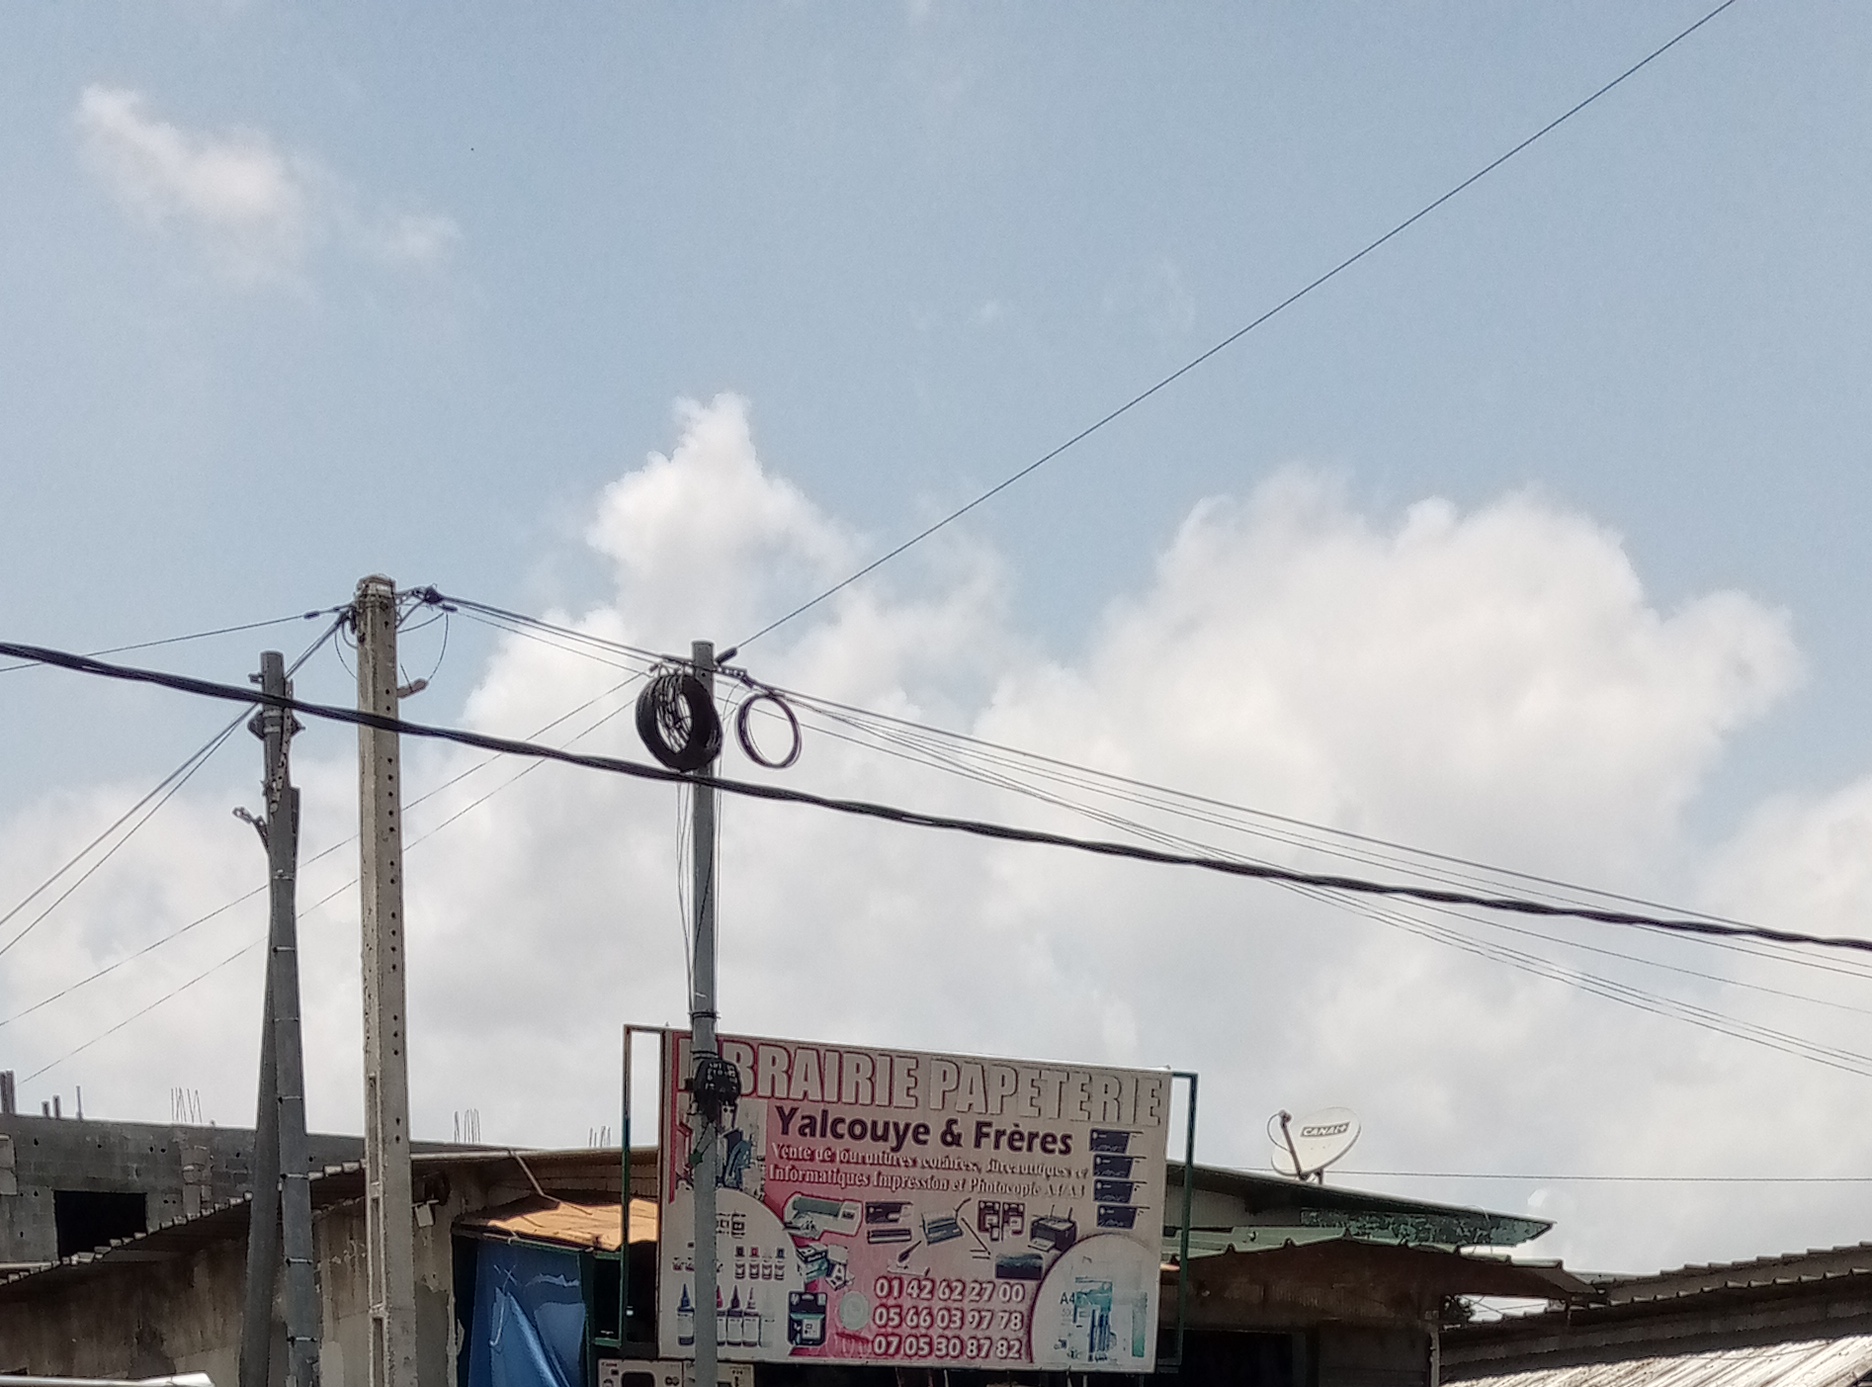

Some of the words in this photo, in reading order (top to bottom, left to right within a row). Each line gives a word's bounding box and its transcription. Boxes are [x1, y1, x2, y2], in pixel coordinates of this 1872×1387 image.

[677, 1036, 919, 1109] LBRAIRIE
[929, 1055, 1162, 1127] PAPETERIE
[774, 1104, 930, 1152] Yalcouye
[940, 1117, 964, 1149] &
[973, 1120, 1073, 1156] Frères
[771, 1142, 813, 1160] Vente
[815, 1146, 833, 1161] de
[769, 1163, 869, 1188] Informatiques
[873, 1170, 950, 1192] Impression
[952, 1178, 966, 1191] et
[969, 1176, 1040, 1197] Photocopie
[875, 1276, 900, 1298] 01
[906, 1278, 932, 1299] 42
[937, 1279, 962, 1300] 62
[968, 1280, 993, 1302] 27
[998, 1281, 1024, 1303] 00
[873, 1306, 900, 1327] 05
[905, 1307, 931, 1328] 66
[936, 1308, 962, 1329] 03
[967, 1309, 993, 1330] 97
[998, 1310, 1023, 1332] 78
[873, 1334, 898, 1356] 07
[903, 1335, 929, 1357] 05
[935, 1336, 960, 1358] 30
[965, 1337, 991, 1359] 87
[995, 1338, 1021, 1359] 82
